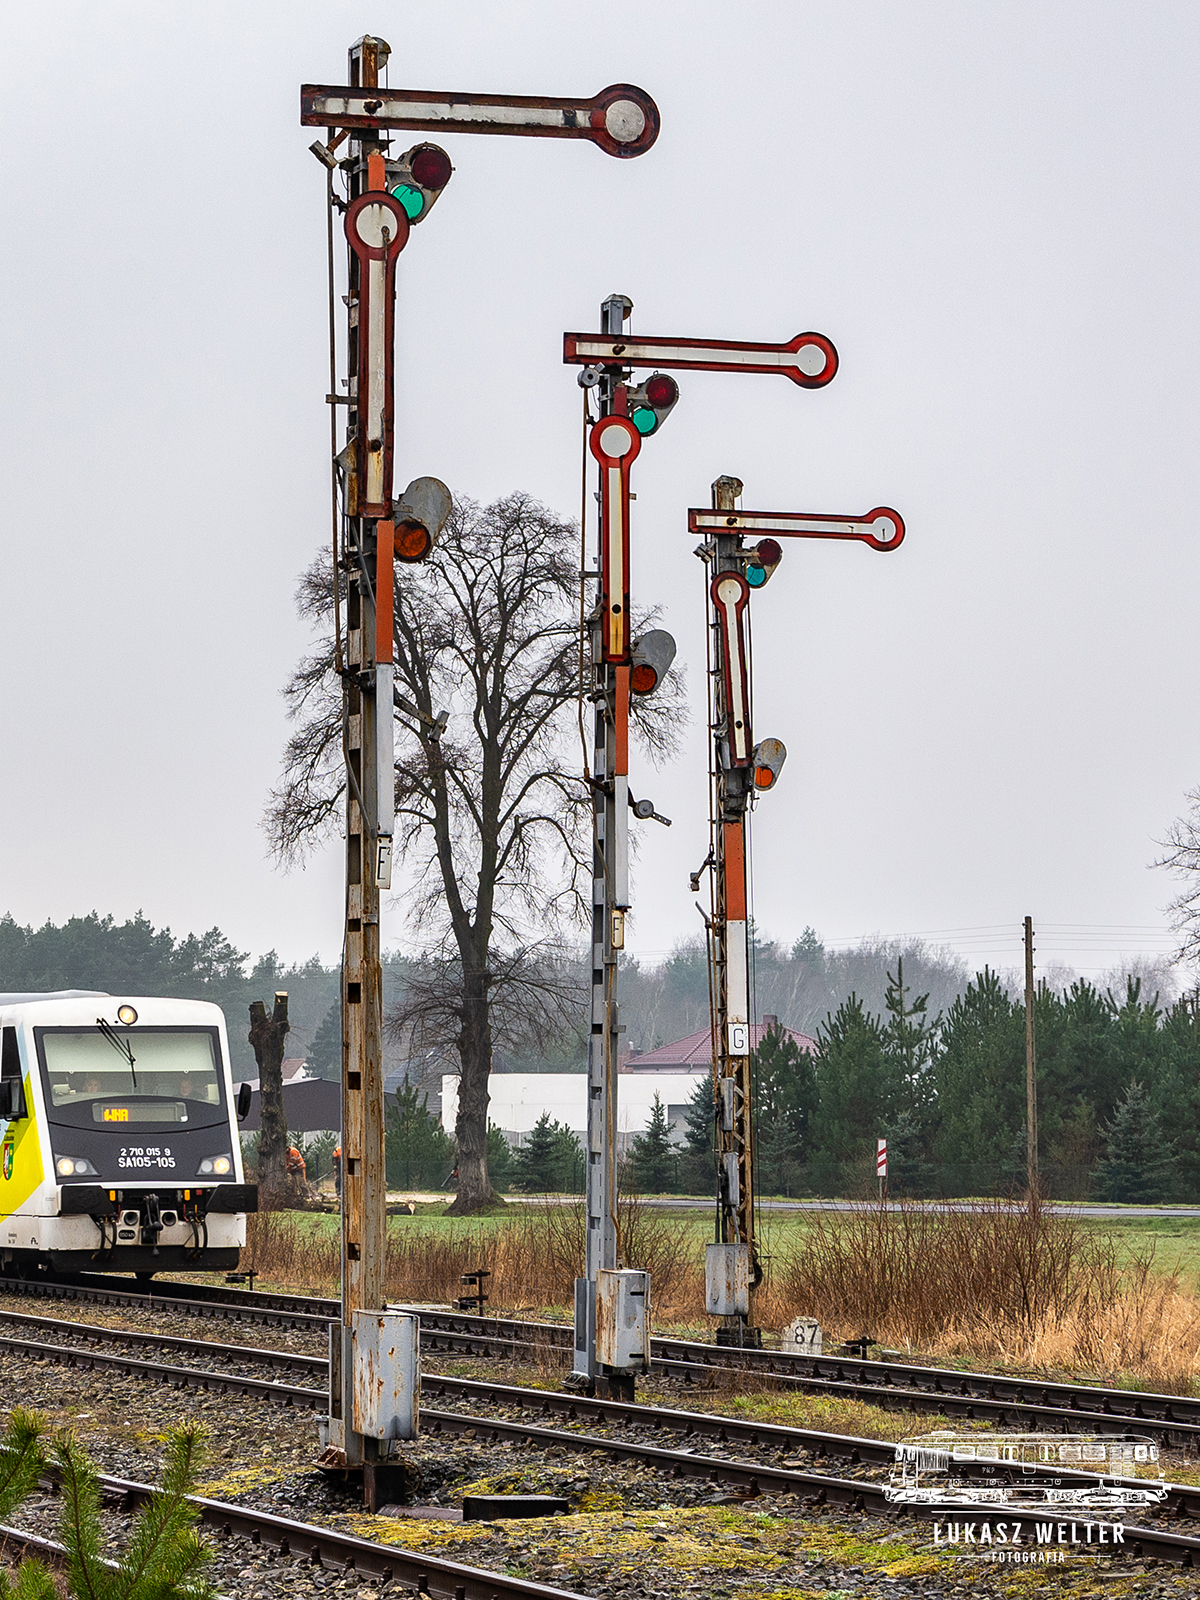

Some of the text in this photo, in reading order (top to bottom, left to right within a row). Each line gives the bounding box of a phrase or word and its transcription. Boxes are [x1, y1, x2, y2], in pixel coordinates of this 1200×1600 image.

[733, 1028, 744, 1049] G
[120, 1147, 171, 1156] 2 710 015 9
[118, 1157, 176, 1168] SA105-105
[794, 1323, 820, 1346] 87
